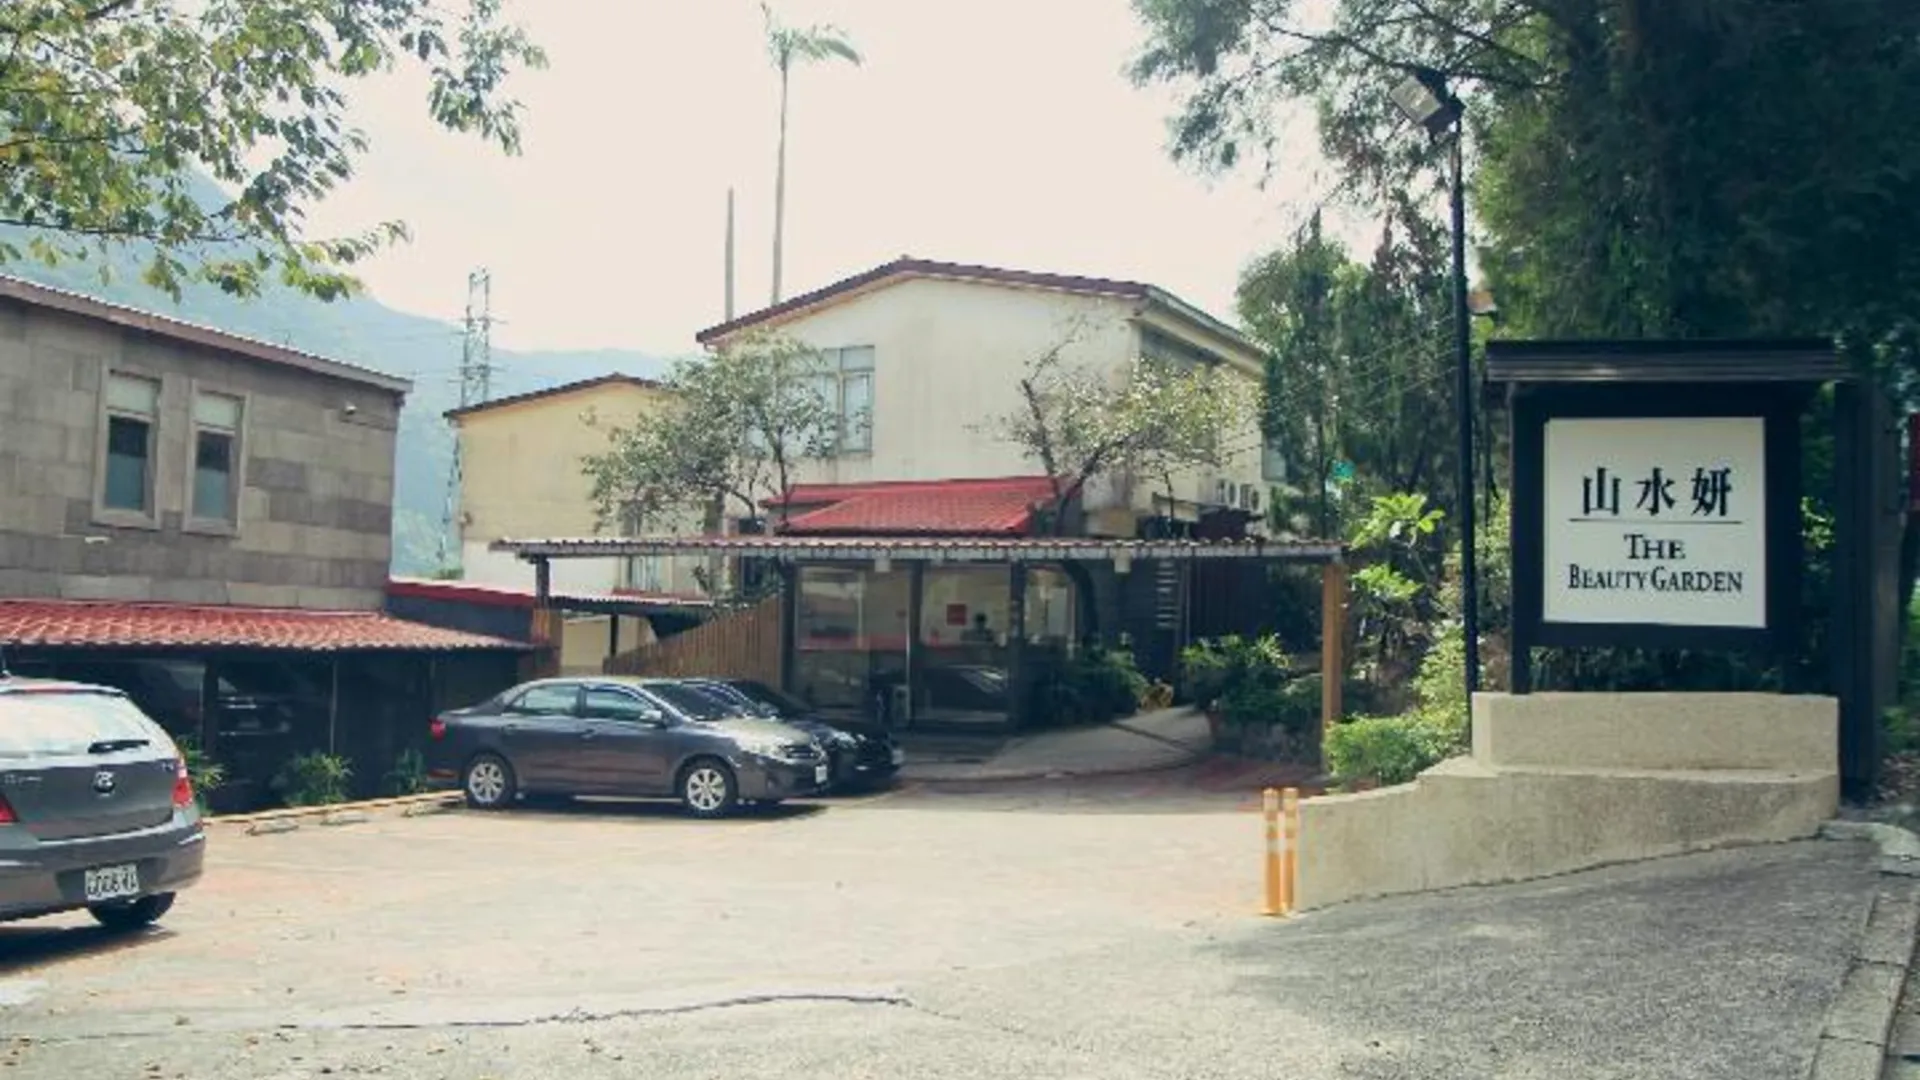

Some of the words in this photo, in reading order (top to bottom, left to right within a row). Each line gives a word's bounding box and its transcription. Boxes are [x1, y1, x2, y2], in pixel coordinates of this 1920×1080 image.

[1582, 466, 1732, 516] 山水妍
[1624, 533, 1686, 560] THE
[1567, 563, 1647, 590] BEAUTY
[1651, 565, 1743, 593] GARDEN
